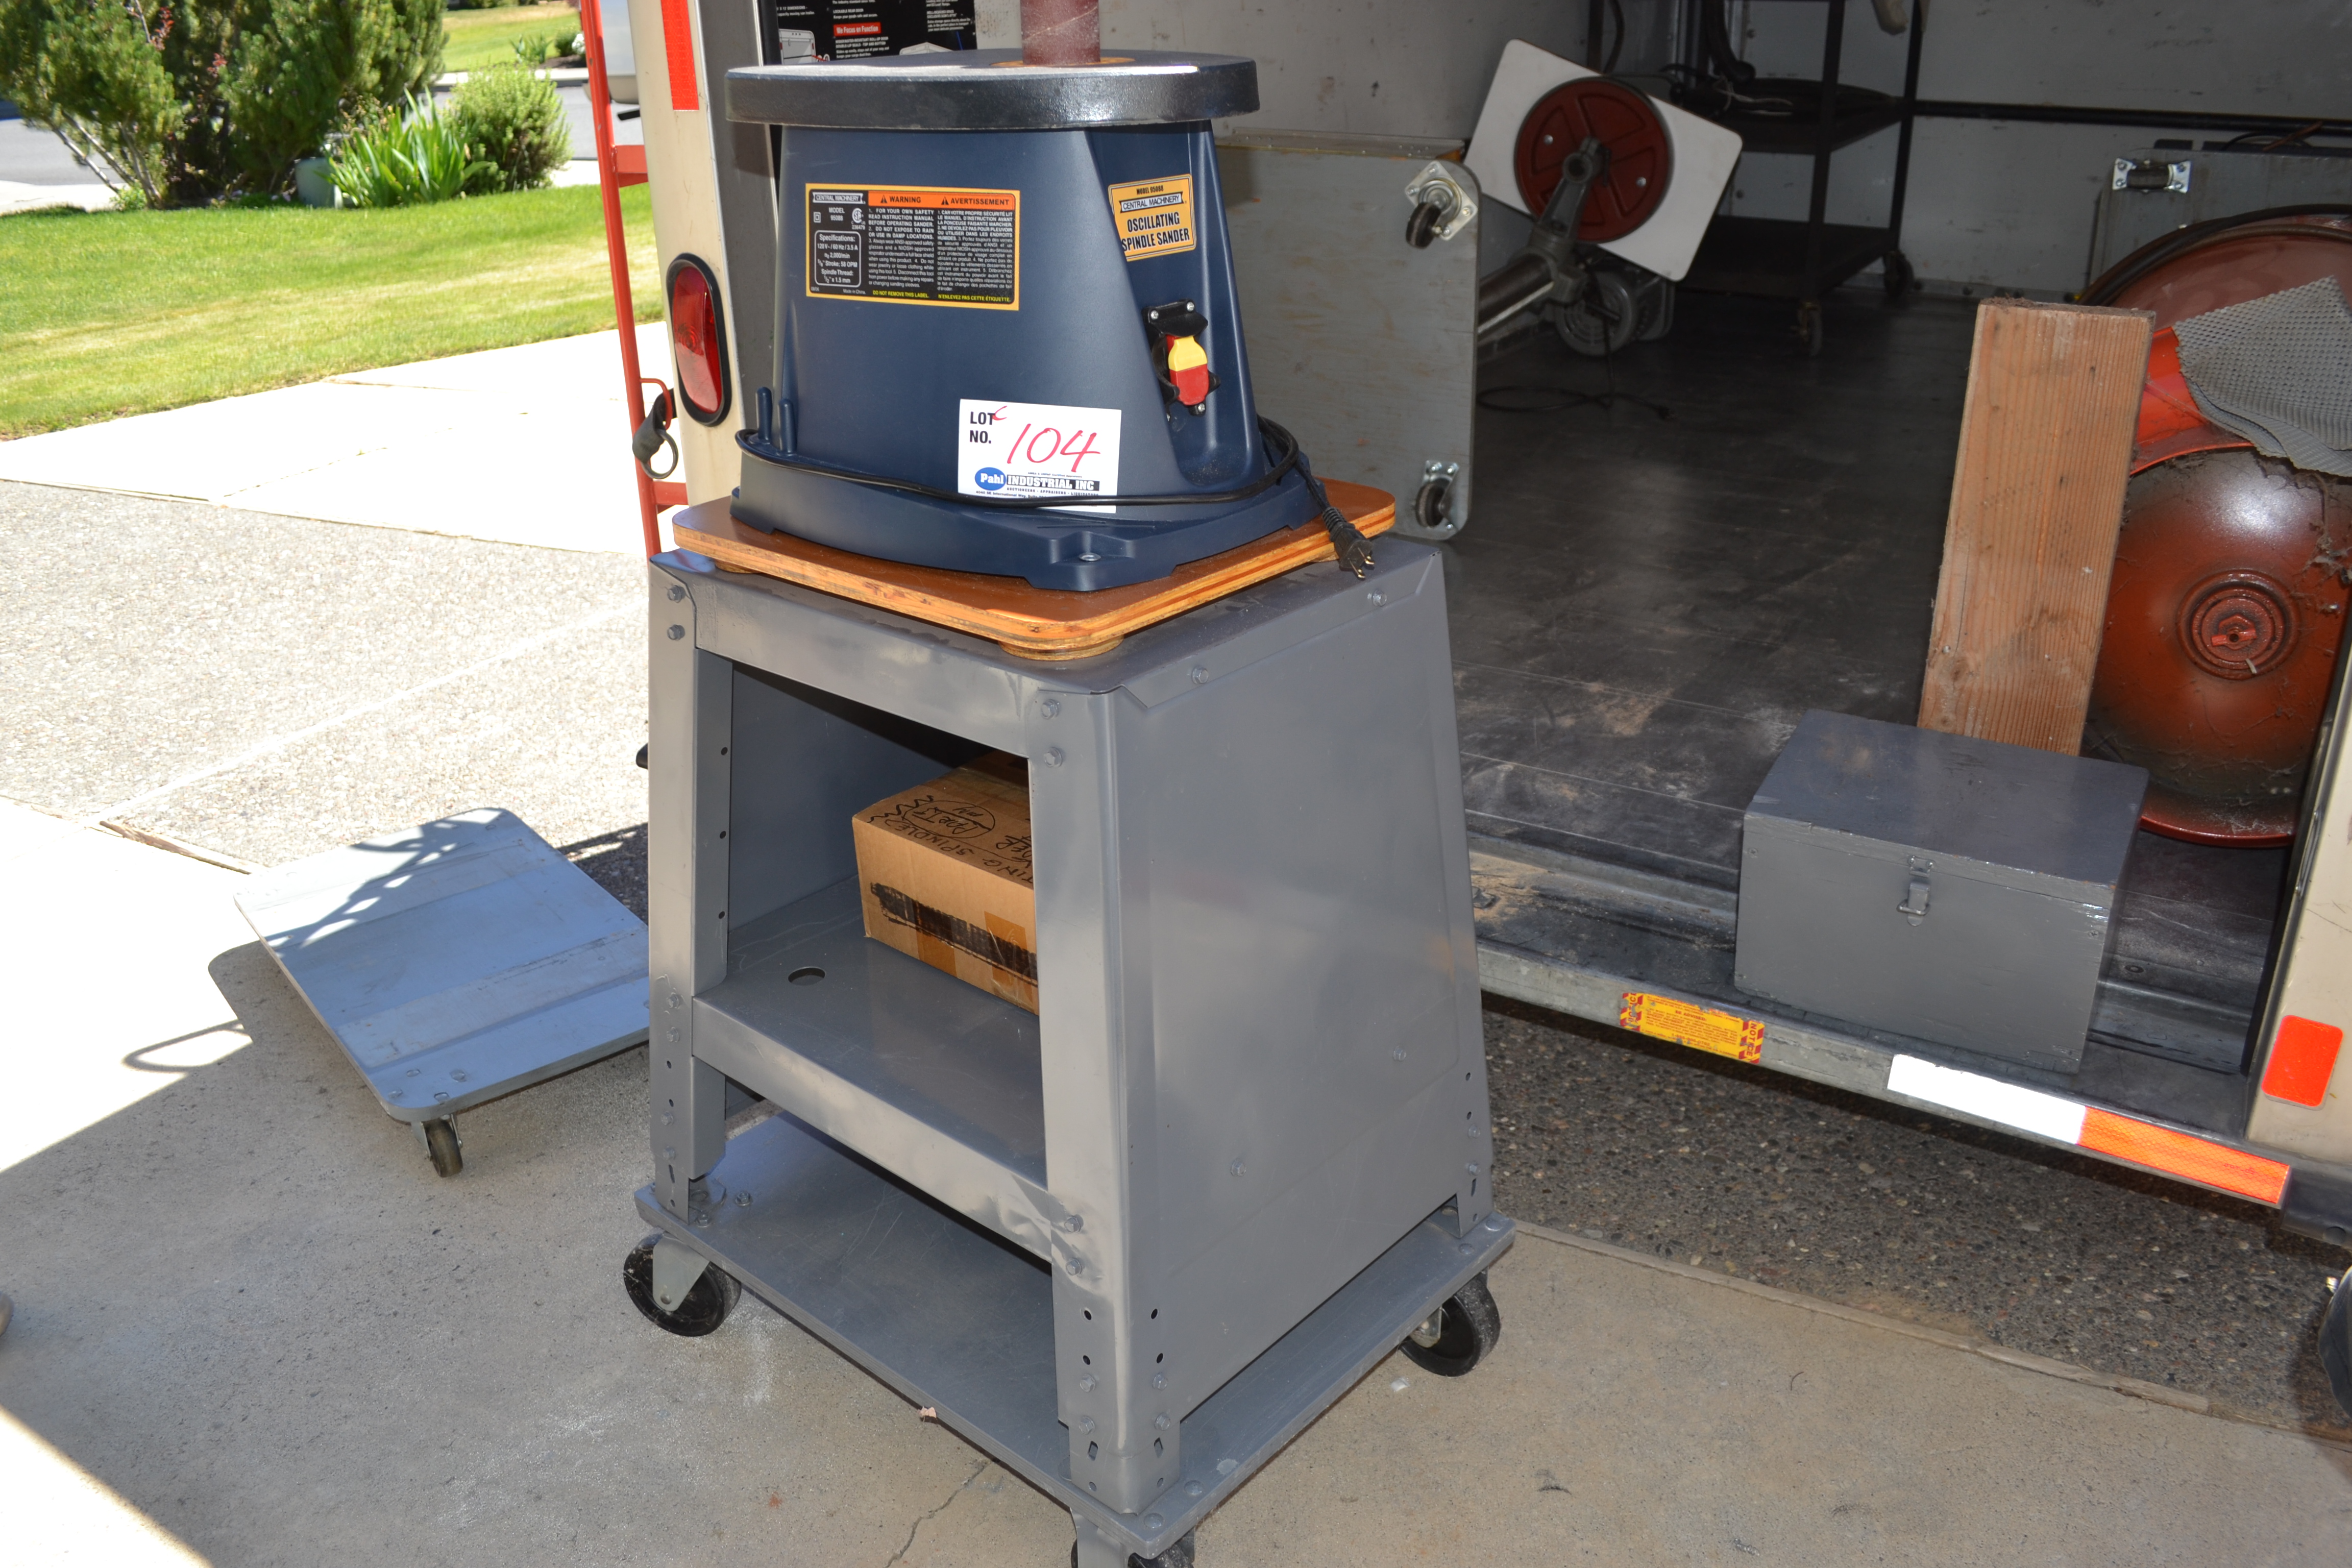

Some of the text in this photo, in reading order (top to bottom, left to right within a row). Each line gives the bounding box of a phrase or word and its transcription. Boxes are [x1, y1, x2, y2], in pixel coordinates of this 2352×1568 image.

[1123, 195, 1180, 210] CENTRAL MACHINERY
[1127, 212, 1180, 232] OSCILLATING
[1122, 228, 1190, 251] SPINDLE SANDER
[970, 411, 995, 425] LOT
[969, 430, 992, 444] NO.
[1007, 423, 1101, 472] 104
[980, 473, 1094, 490] Pahl INDUSTRIAL INC
[912, 807, 978, 834] PARTS
[895, 823, 974, 855] SPINDLE
[1746, 1023, 1757, 1057] NOTICE
